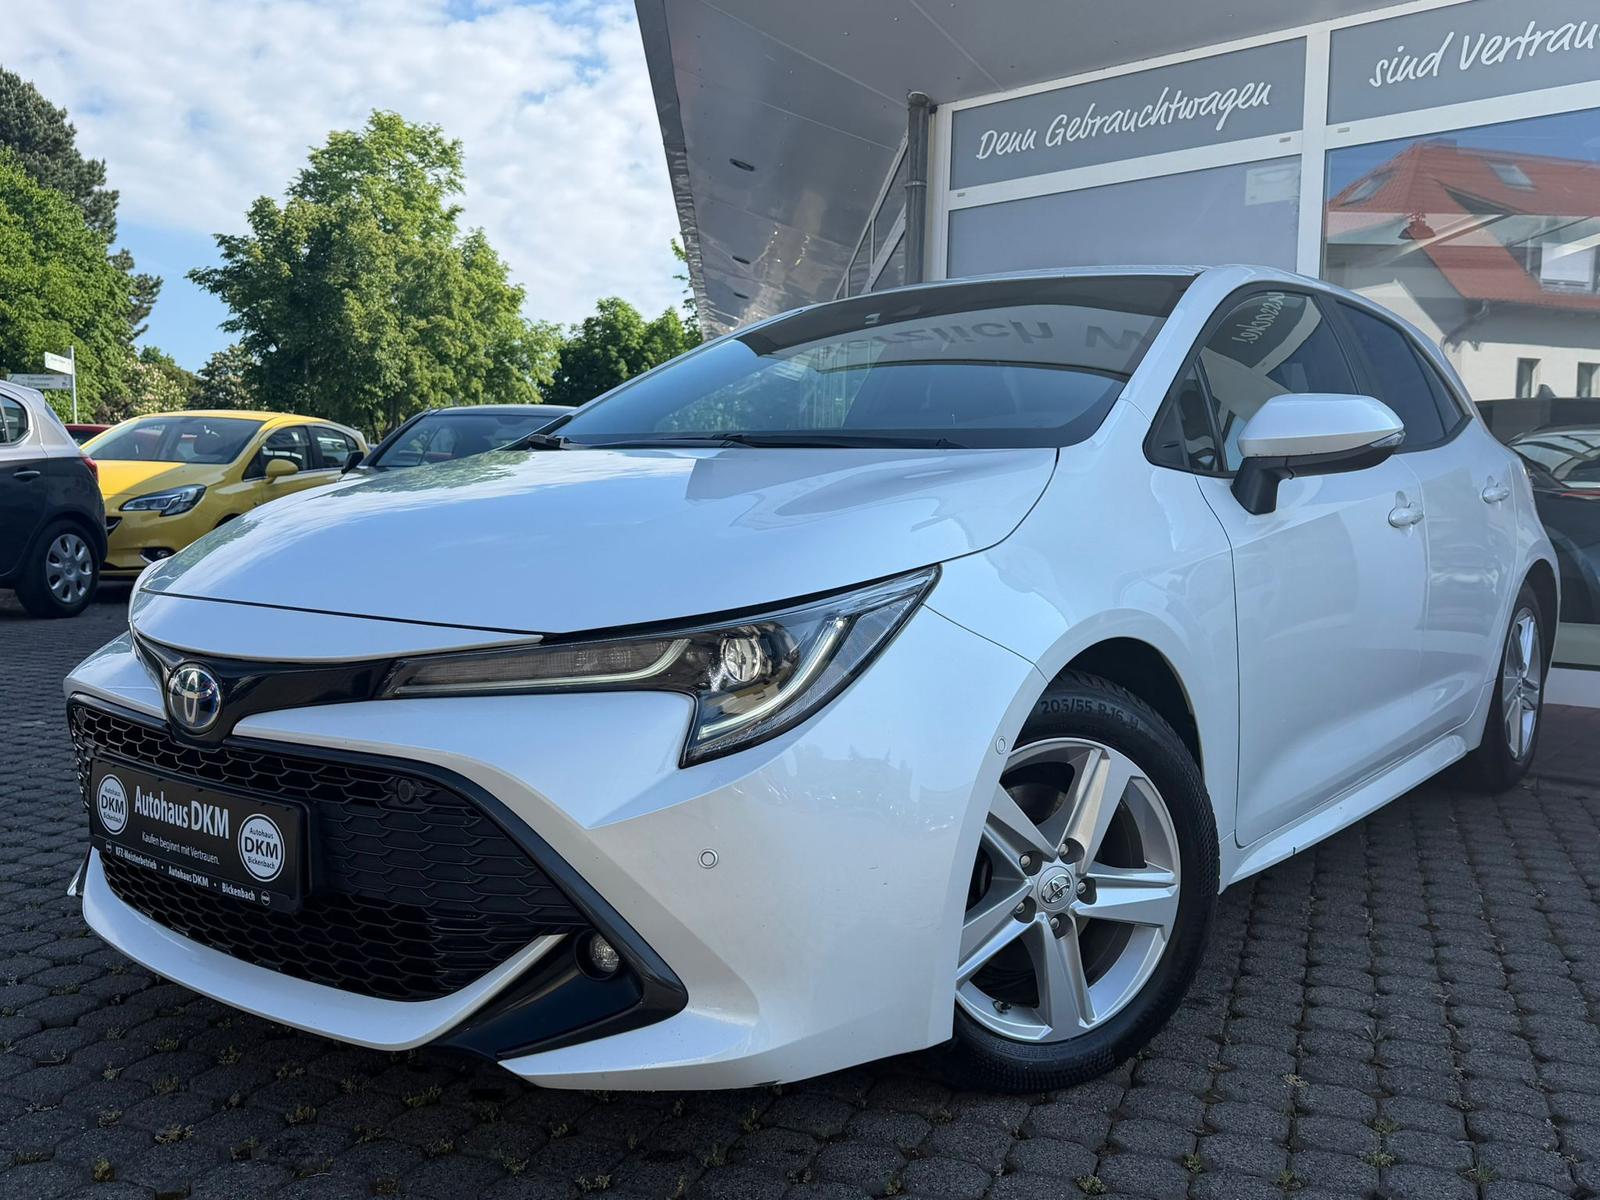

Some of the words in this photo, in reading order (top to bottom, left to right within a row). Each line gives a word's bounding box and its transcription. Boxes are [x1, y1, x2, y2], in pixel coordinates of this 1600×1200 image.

[1369, 31, 1454, 88] sind
[1459, 20, 1600, 70] Vertrau
[976, 128, 1037, 160] Denn
[1045, 82, 1272, 147] Gebrauchtwagen
[1041, 698, 1093, 713] 205/55
[101, 795, 124, 815] DKM
[135, 785, 189, 829] Autohaus
[191, 800, 229, 839] DKM
[249, 827, 274, 839] Autohaus
[244, 836, 278, 860] DKM
[247, 855, 276, 870] Bickenbach
[192, 873, 209, 888] DKM
[222, 882, 255, 901] Bickenbach
